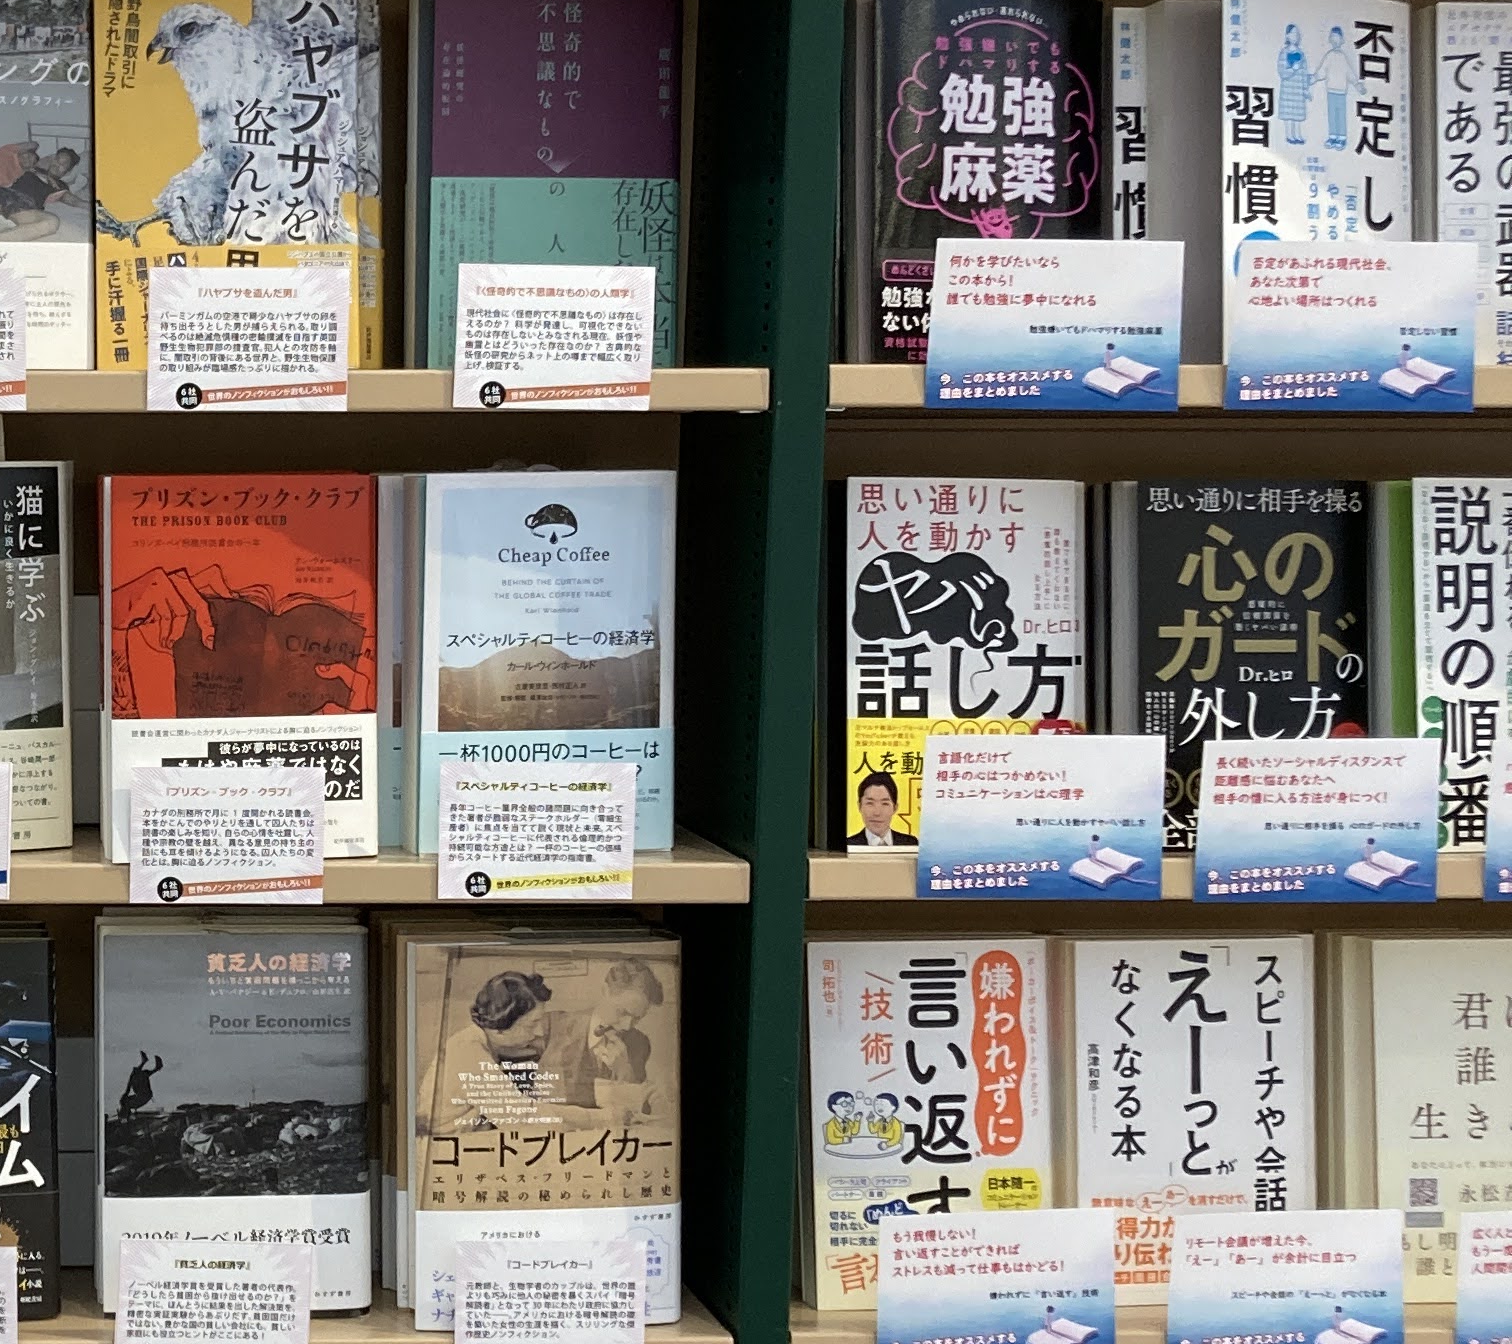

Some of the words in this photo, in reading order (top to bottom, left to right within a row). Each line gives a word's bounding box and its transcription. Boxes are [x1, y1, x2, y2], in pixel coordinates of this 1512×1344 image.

[563, 2, 583, 111] 怪奇的で
[536, 3, 557, 162] 不思議なもの
[277, 0, 341, 242] ハヤブサを
[939, 73, 1056, 138] 勉強
[1354, 20, 1396, 233] 否定し
[228, 97, 276, 245] 盗んだ
[1225, 86, 1279, 227] 習慣
[939, 144, 1056, 205] 麻薬
[950, 255, 1060, 270] 何かを学びたいなら
[946, 293, 1097, 308] 誰でも勉強に夢中になれる
[1249, 294, 1378, 309] 心地よい場所はつくれる
[131, 485, 365, 512] プリズン・ブック・クラブ
[857, 484, 1025, 516] 思い通りに
[1146, 488, 1362, 514] 思い通りに相手を操る
[132, 515, 157, 527] THE
[163, 515, 210, 527] PRISON
[215, 514, 251, 526] BOOK
[255, 514, 288, 526] CLUB
[857, 521, 1025, 553] 人を動かす
[15, 485, 46, 623] 猫に学ぶ
[498, 546, 552, 566] Cheap
[556, 546, 610, 563] Coffee
[1177, 524, 1335, 602] 心の
[446, 630, 655, 648] スペシャルティコーヒーの経済学
[855, 643, 1084, 720] 話し方
[218, 740, 361, 755] 彼らが夢中になっているのは
[438, 741, 660, 762] 一杯1000円のコーヒーは
[935, 787, 1085, 801] コミュニケーションは心理学
[206, 952, 352, 973] 貧乏人の経済学
[209, 1014, 251, 1029] Poor
[255, 1014, 351, 1029] Economics
[979, 962, 1021, 1147] 嫌われずに
[1110, 959, 1148, 1163] なくなる本
[431, 1129, 672, 1168] コードブレイカー
[432, 1185, 672, 1204] 暗号解読の秘められし歴史
[892, 1227, 977, 1244] もう我慢しない!
